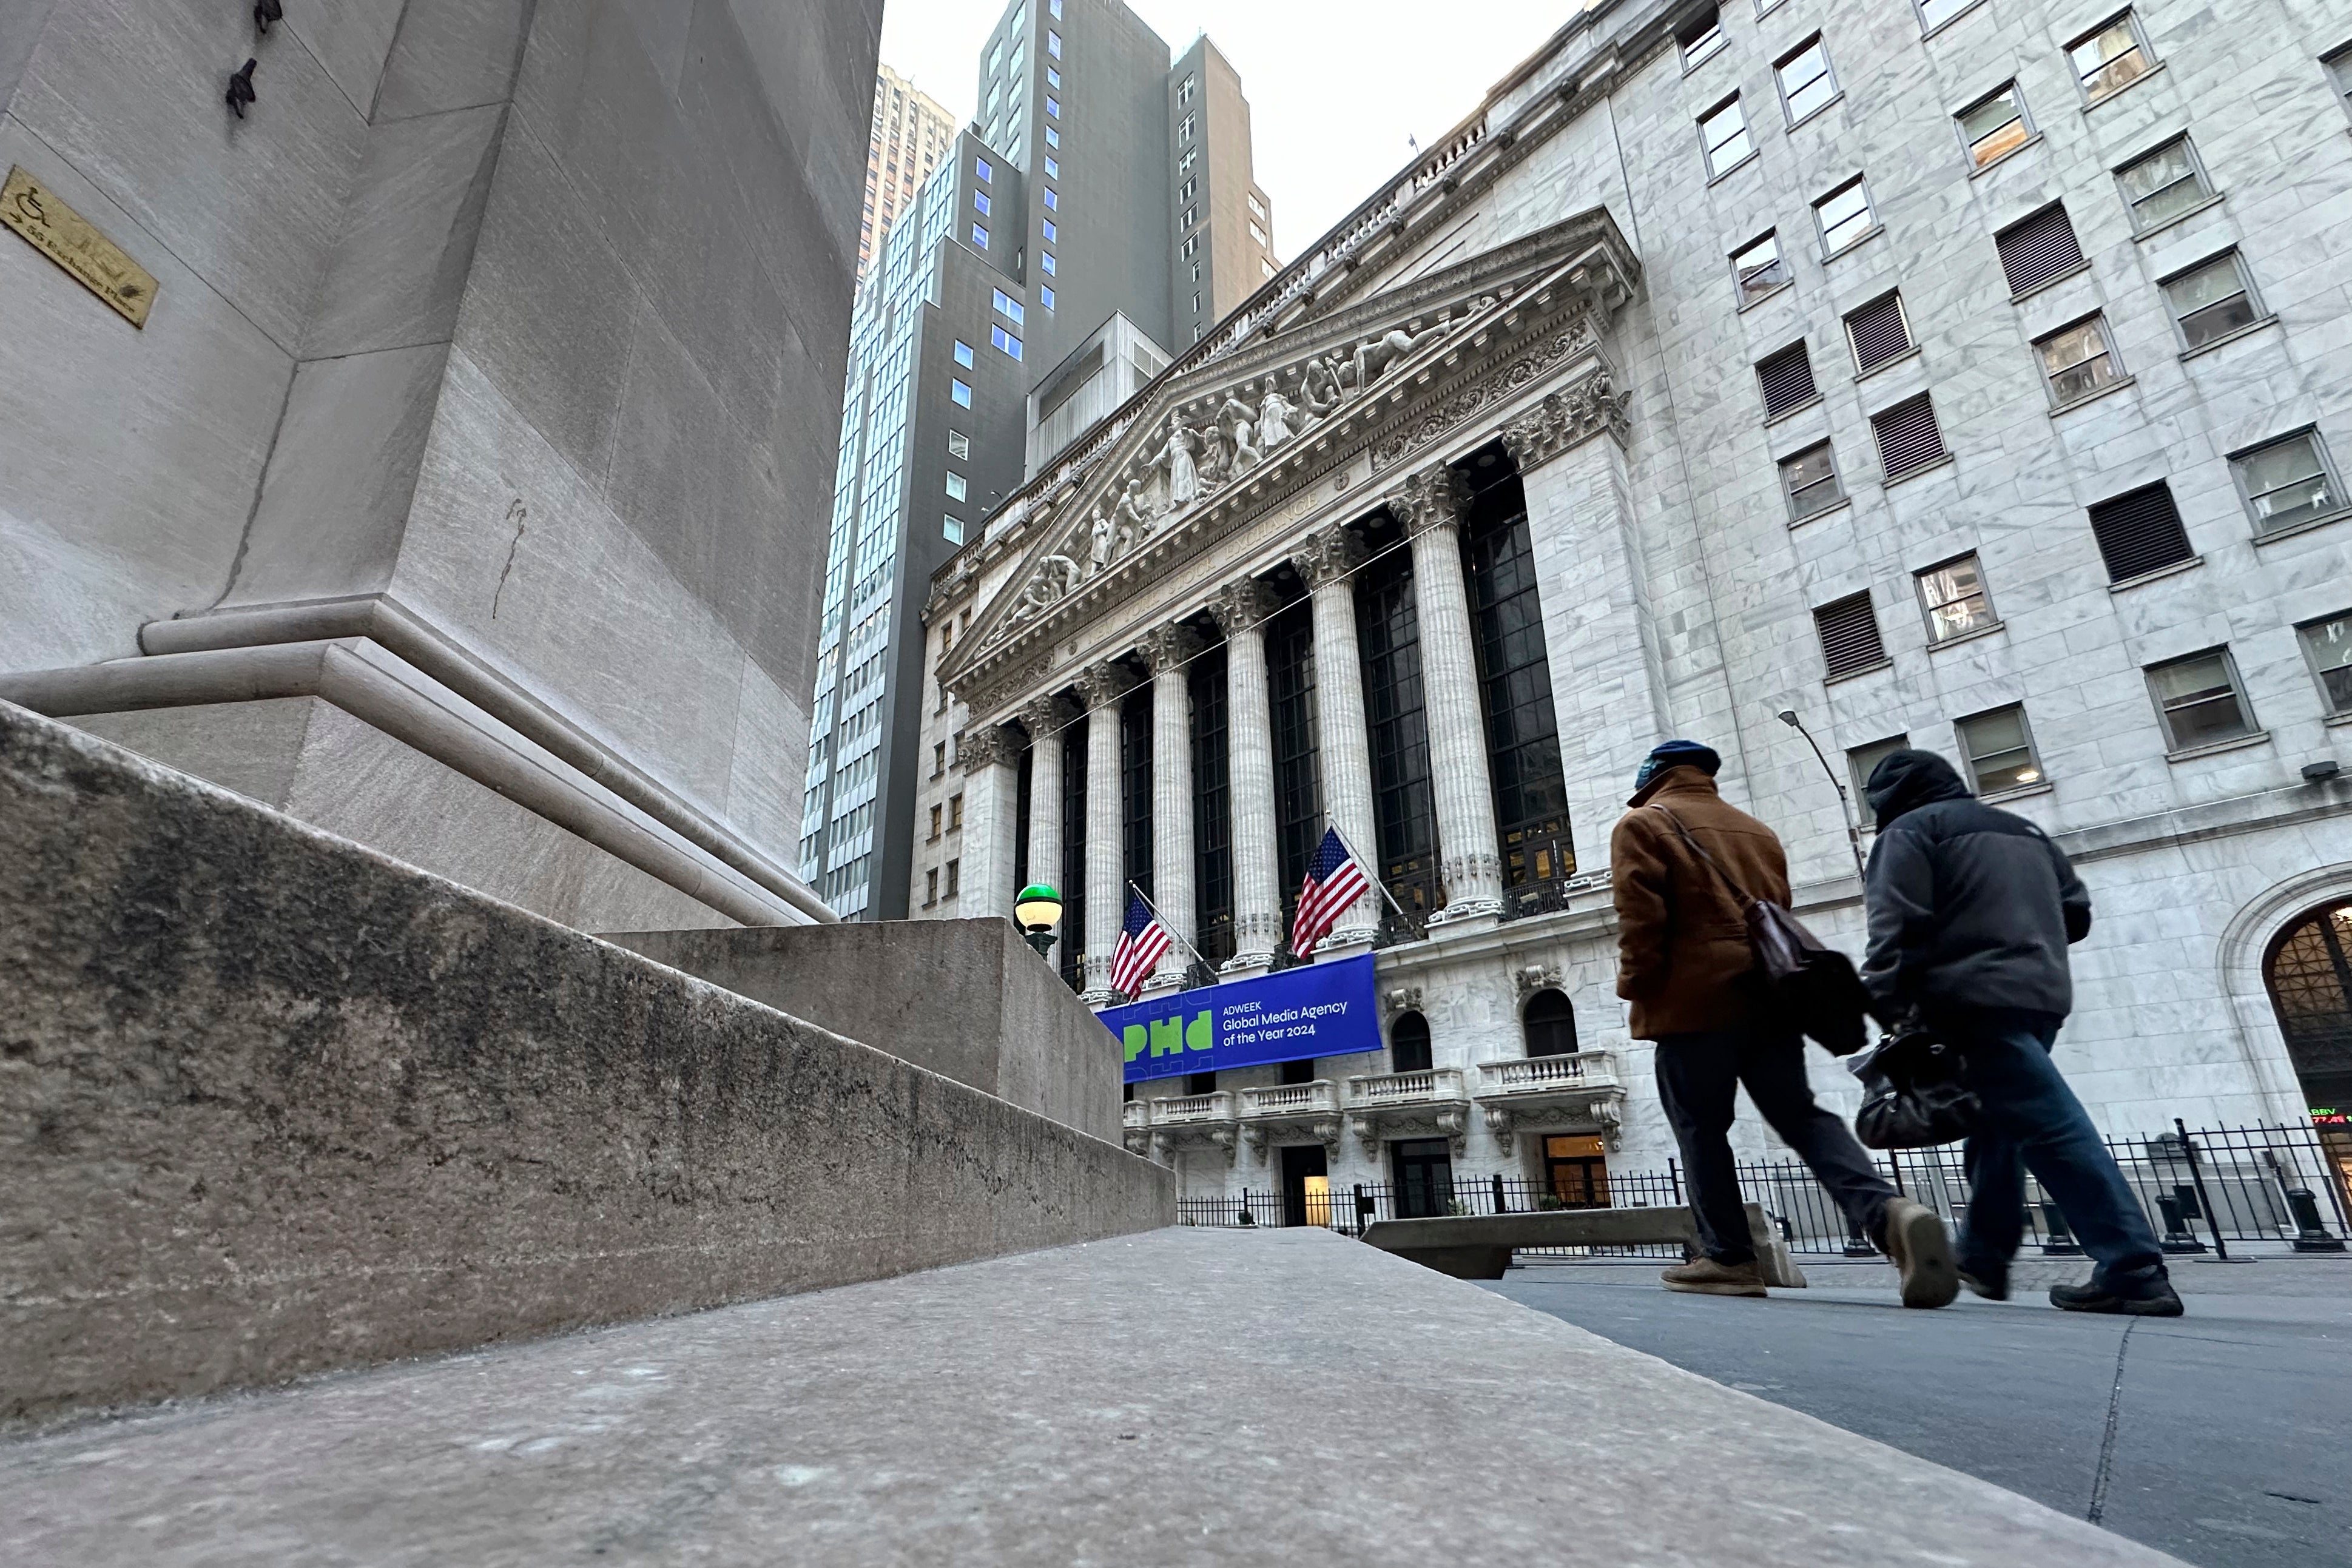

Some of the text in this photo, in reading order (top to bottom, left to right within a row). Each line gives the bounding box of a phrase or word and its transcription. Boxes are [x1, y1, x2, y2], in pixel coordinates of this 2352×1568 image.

[27, 224, 135, 314] 55 Exchange Place
[1122, 591, 1161, 622] YORK
[1167, 557, 1216, 594] STOCK
[1225, 492, 1318, 560] EXCHANGE
[1222, 1001, 1262, 1017] ADWEEK
[1222, 1001, 1347, 1031] Global Media Agency
[1223, 1024, 1316, 1047] of the Year 2024
